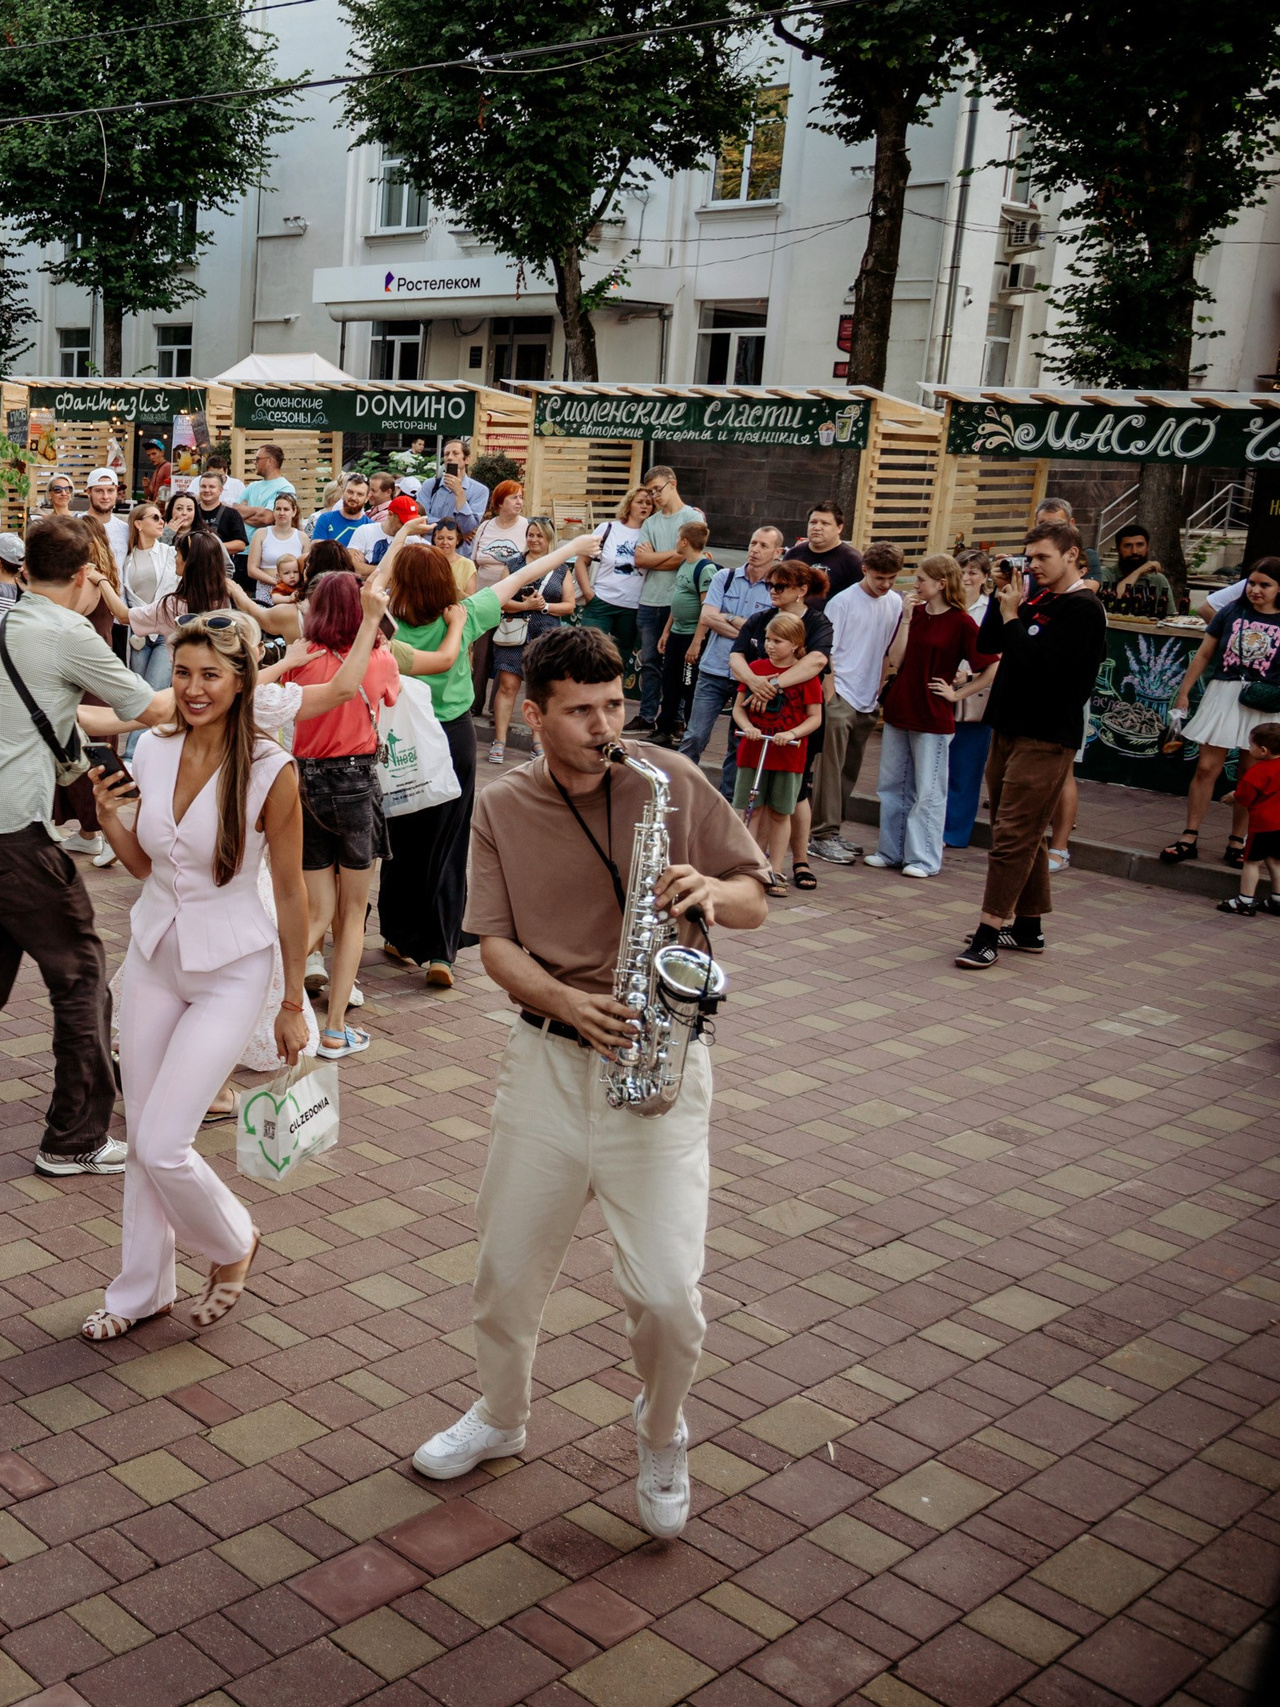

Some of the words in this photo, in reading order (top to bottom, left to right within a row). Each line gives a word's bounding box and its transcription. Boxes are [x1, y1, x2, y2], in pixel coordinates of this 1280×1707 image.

[397, 277, 480, 292] Ростелеком
[254, 393, 323, 410] Смоленские
[544, 396, 688, 427] Смоленские
[268, 410, 311, 424] сезоны
[579, 423, 644, 440] авторские
[651, 426, 714, 443] десерты
[716, 429, 729, 441] и
[733, 429, 804, 446] пряники
[1013, 410, 1221, 459] МАСЛО
